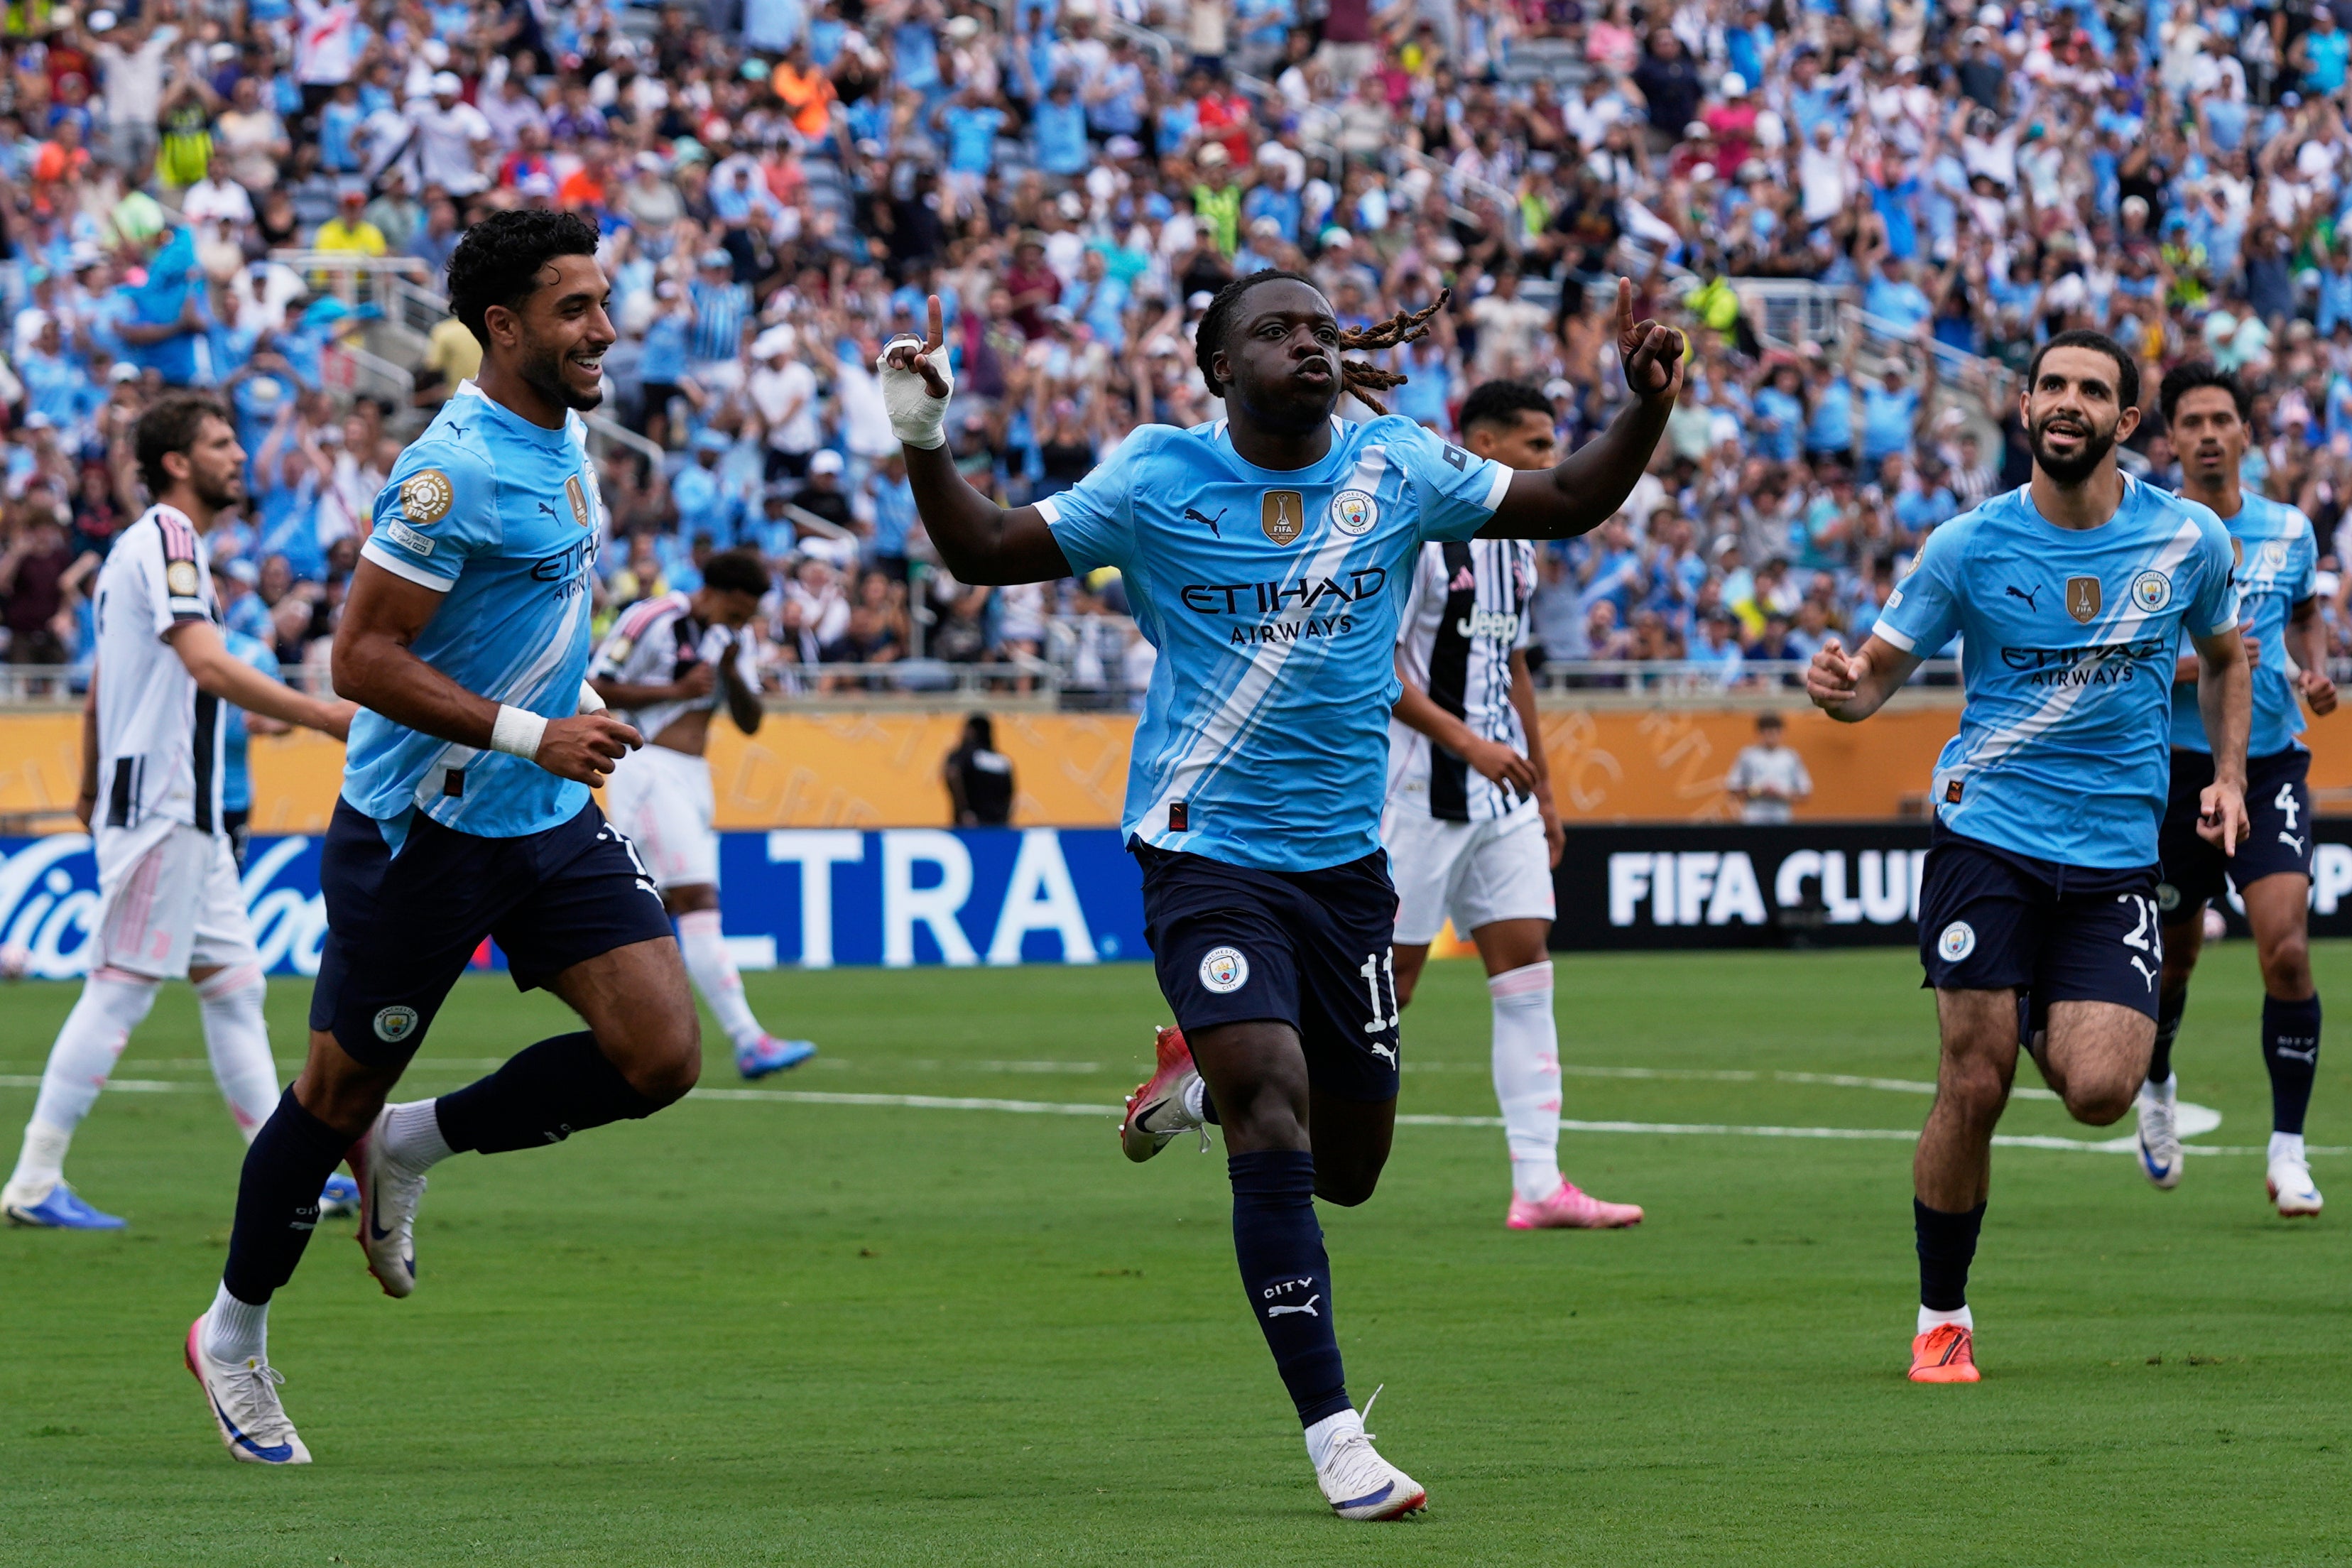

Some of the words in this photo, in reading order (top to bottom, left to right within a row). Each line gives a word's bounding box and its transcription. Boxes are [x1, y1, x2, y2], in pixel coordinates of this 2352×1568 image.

[435, 477, 447, 490] CUP
[1334, 491, 1372, 508] MANCHESTER
[408, 506, 429, 521] FIFA
[1180, 567, 1386, 614] ETIHAD
[2076, 606, 2093, 614] FIFA
[1229, 615, 1352, 645] AIRWAYS
[1457, 601, 1520, 647] Jeep
[2031, 666, 2133, 686] AIRWAYS
[2275, 783, 2299, 829] 4
[1608, 851, 1768, 926] FIFA
[1775, 849, 1925, 924] CLU
[2117, 893, 2162, 963] 21
[1203, 949, 1241, 971] MANCHESTER
[1361, 946, 1399, 1033] 11
[1264, 1277, 1312, 1299] CITY
